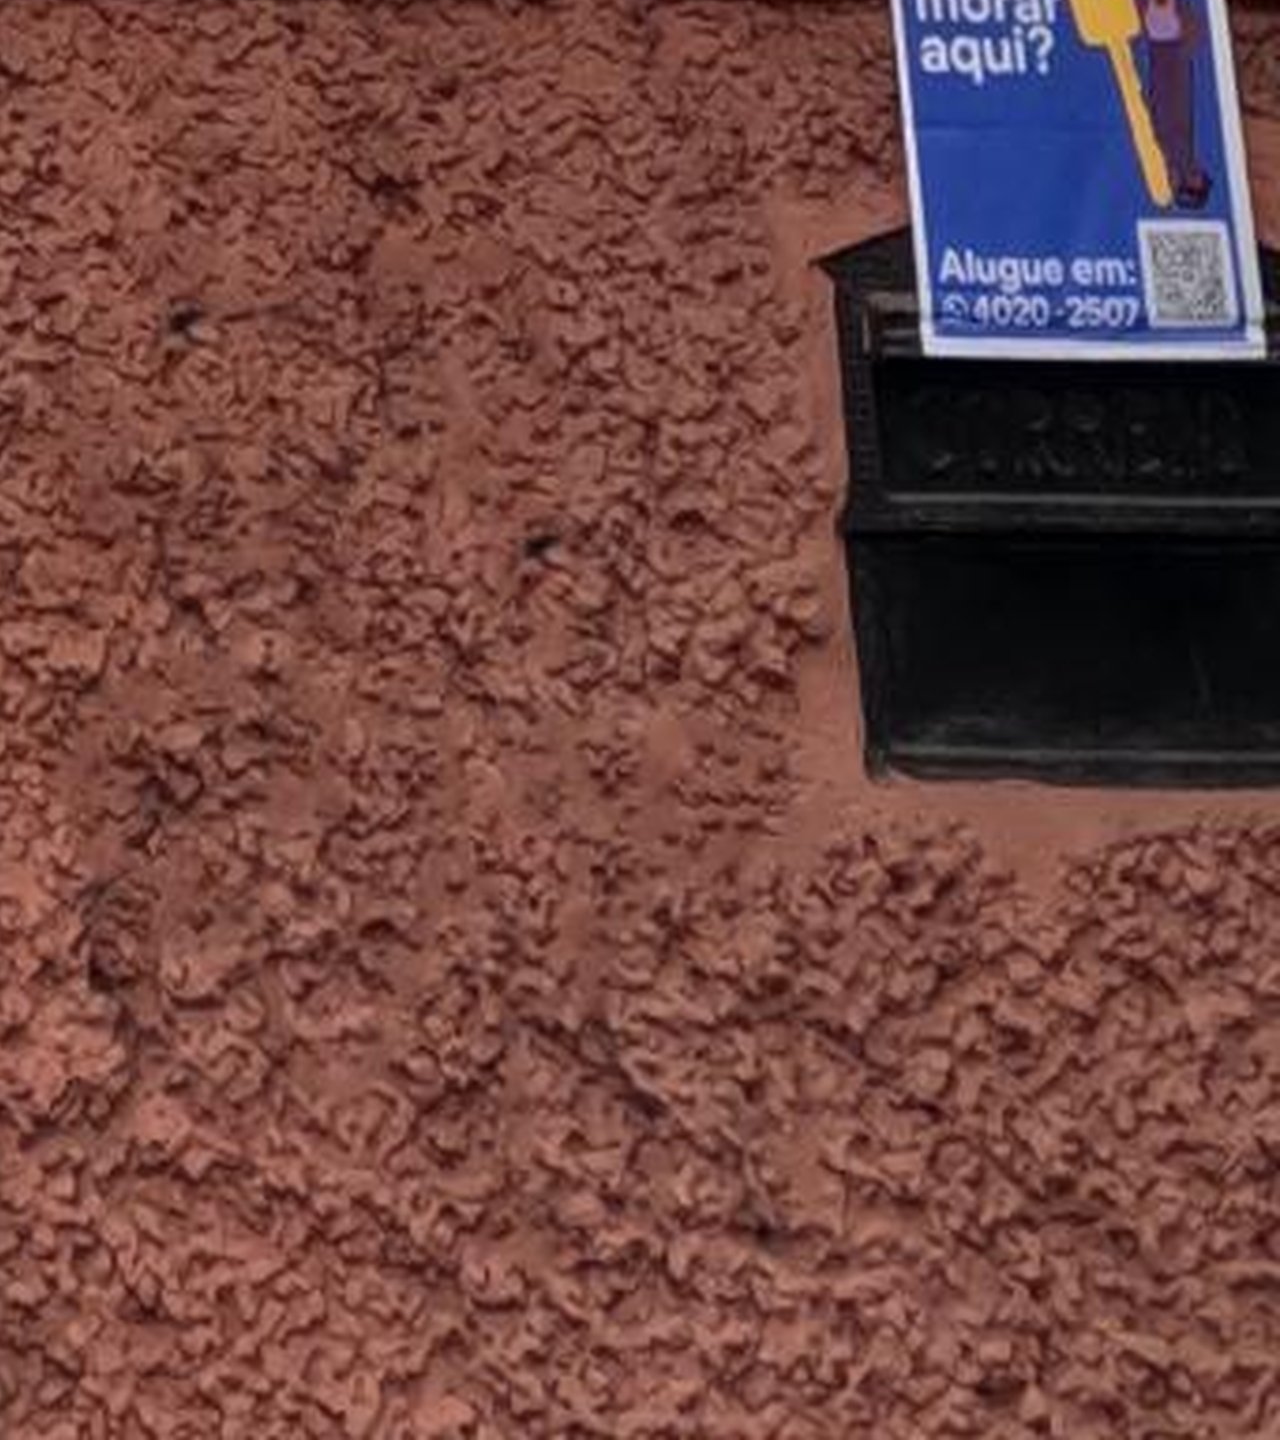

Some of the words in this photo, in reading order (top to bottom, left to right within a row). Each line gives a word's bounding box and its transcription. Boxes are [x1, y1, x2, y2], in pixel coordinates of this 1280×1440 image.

[921, 26, 1055, 84] aqui?
[940, 247, 1064, 293] Alugue
[1071, 257, 1138, 286] em:
